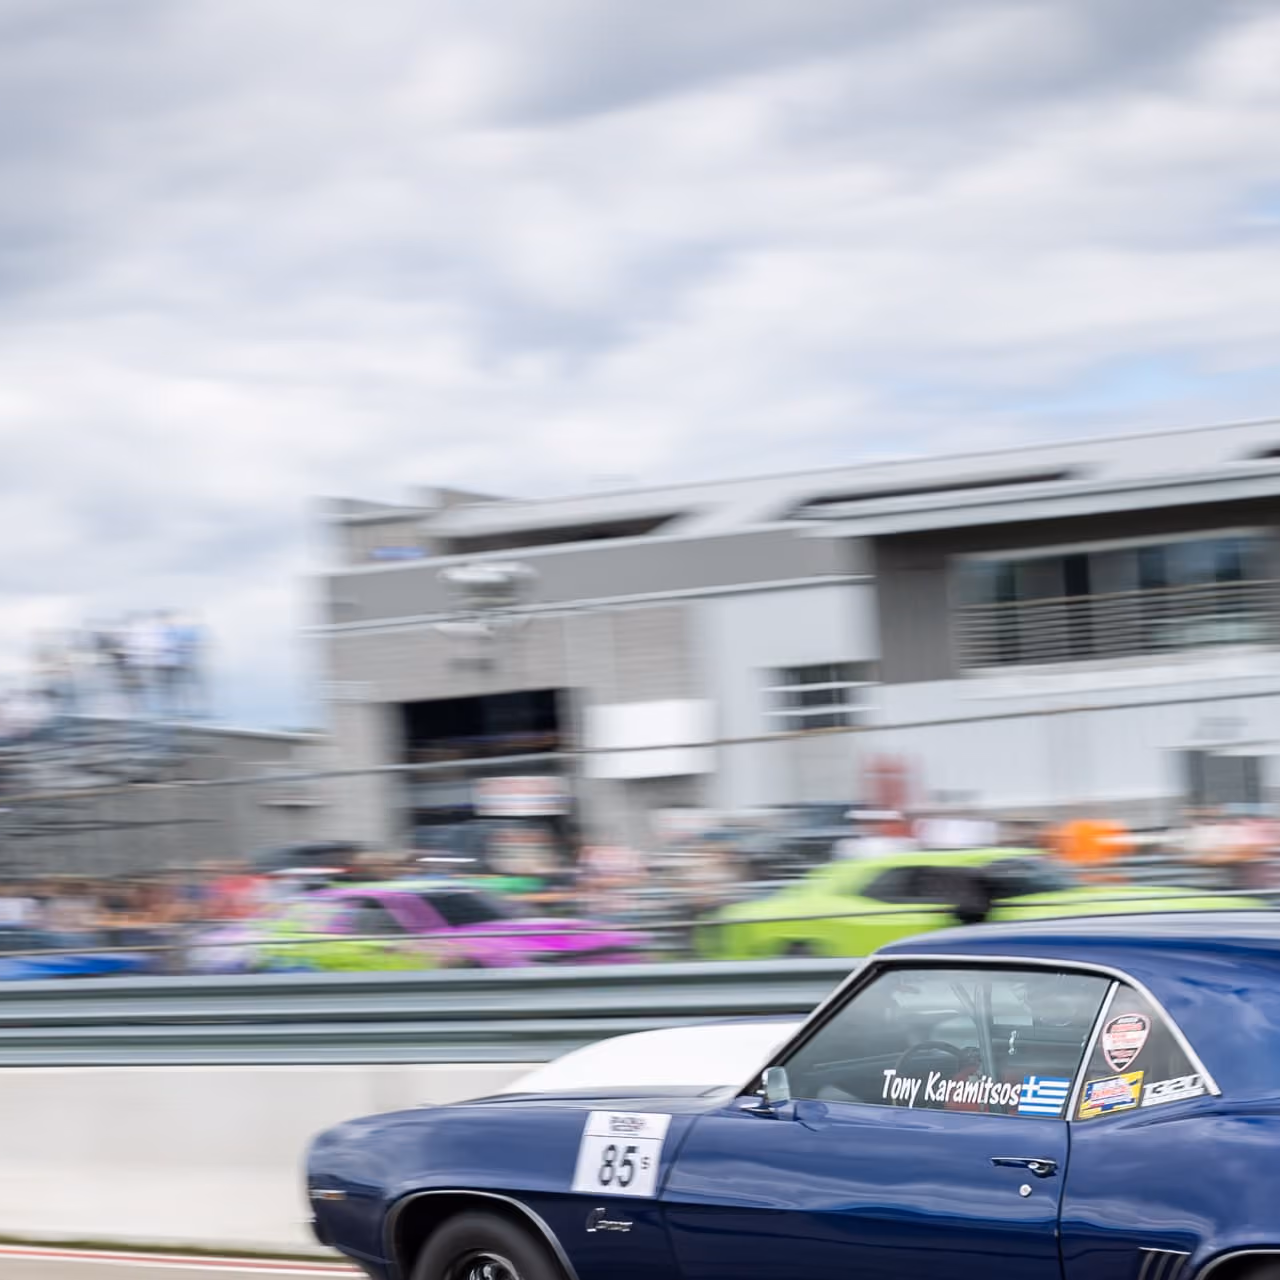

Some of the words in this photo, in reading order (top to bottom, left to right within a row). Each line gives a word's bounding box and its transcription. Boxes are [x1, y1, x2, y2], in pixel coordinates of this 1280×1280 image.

[882, 1068, 922, 1109] Tony
[924, 1071, 1022, 1106] Karamitsos
[598, 1144, 639, 1188] 85
